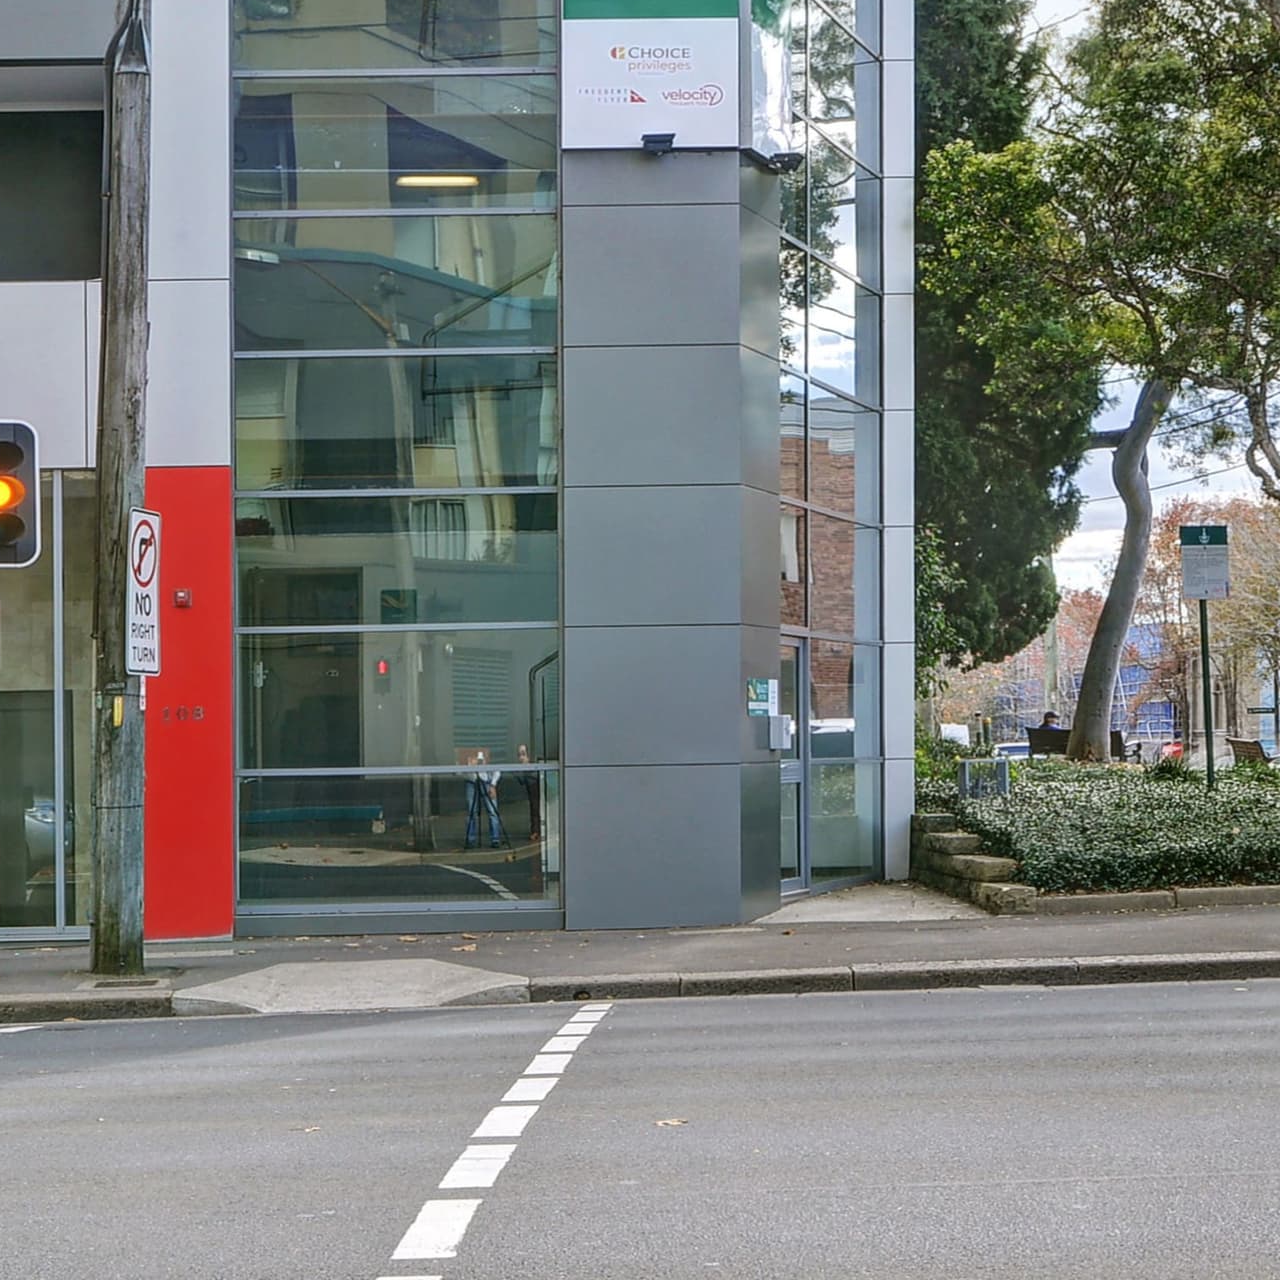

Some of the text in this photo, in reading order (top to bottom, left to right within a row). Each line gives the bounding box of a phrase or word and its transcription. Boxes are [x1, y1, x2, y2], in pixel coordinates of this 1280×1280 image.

[628, 47, 691, 59] CHOICE
[628, 60, 691, 73] privileges
[662, 86, 720, 106] velocity
[135, 593, 152, 616] NO
[131, 622, 155, 640] RIGHT
[132, 646, 156, 663] TURN
